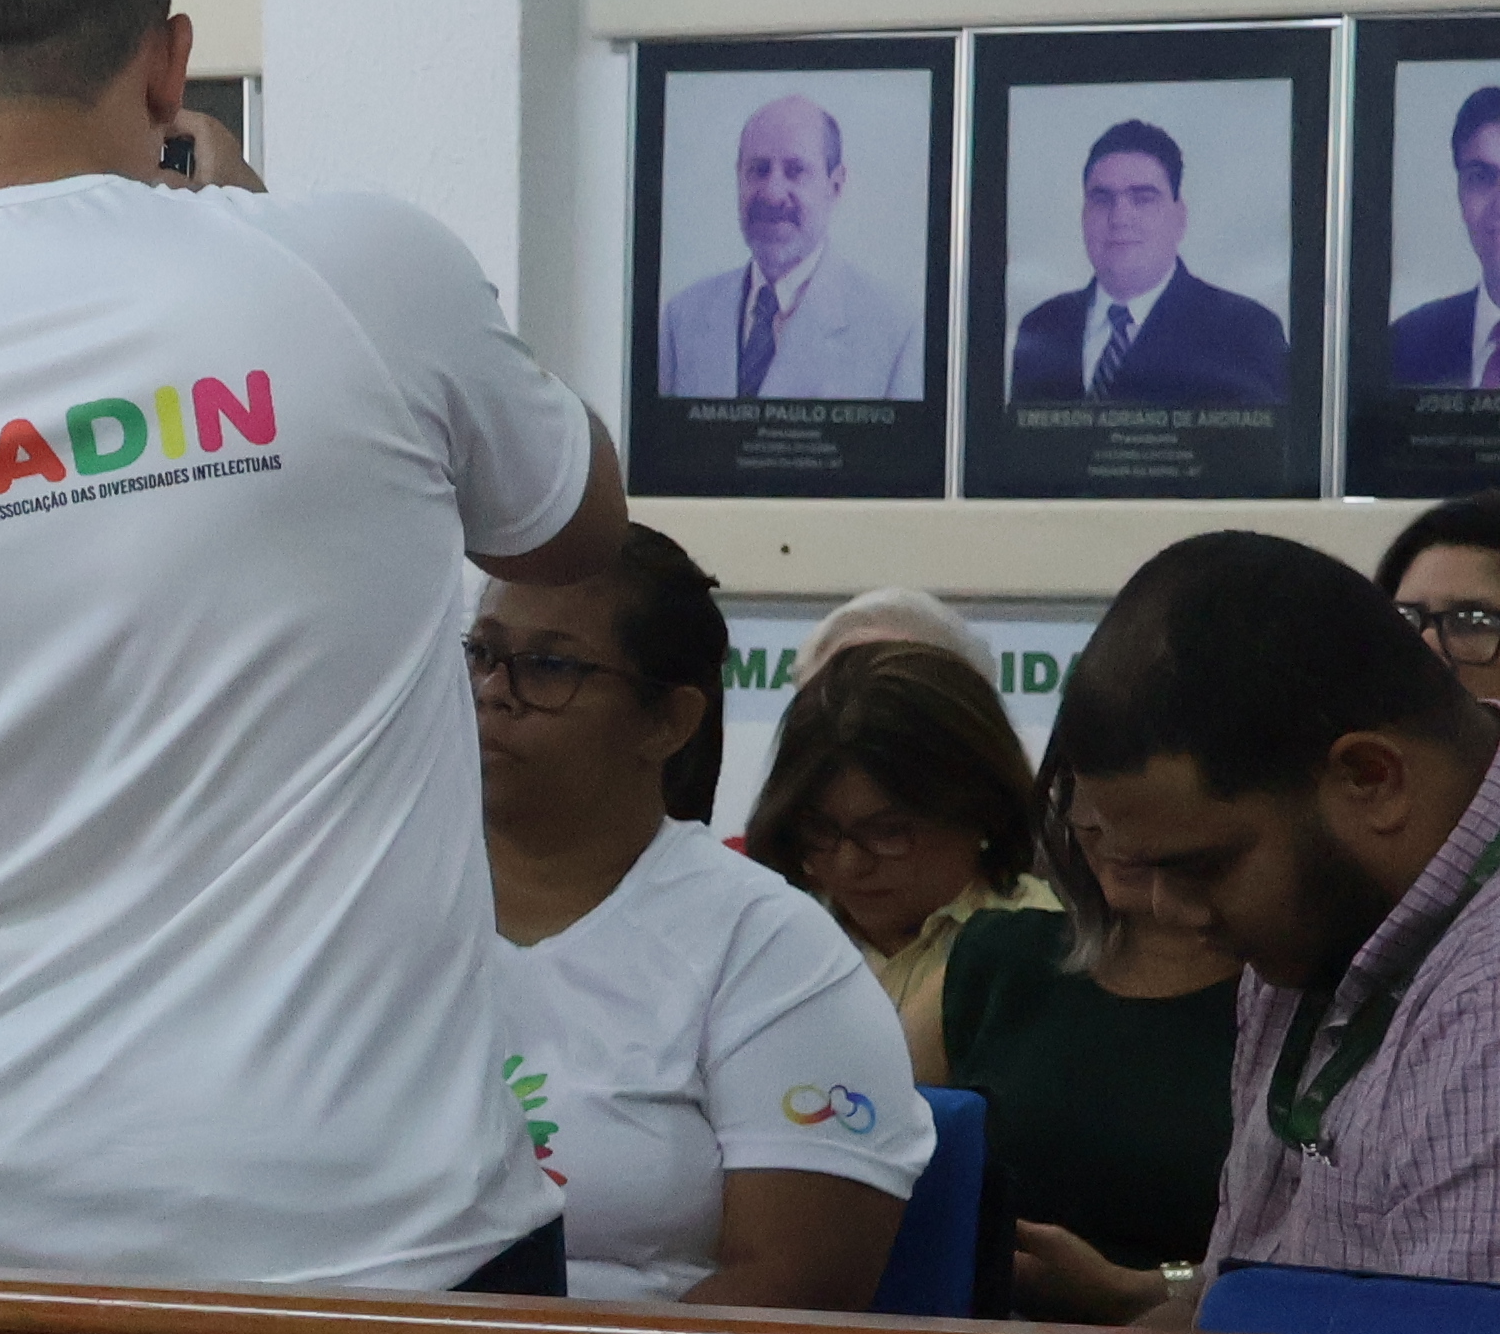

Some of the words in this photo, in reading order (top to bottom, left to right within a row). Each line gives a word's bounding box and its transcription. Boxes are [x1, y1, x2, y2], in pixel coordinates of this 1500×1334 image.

[687, 403, 761, 423] AMAURI
[764, 403, 827, 424] PAULO
[70, 485, 98, 505] DAS
[98, 467, 190, 500] DIVERSIDADES
[192, 454, 283, 481] INTELECTUAIS
